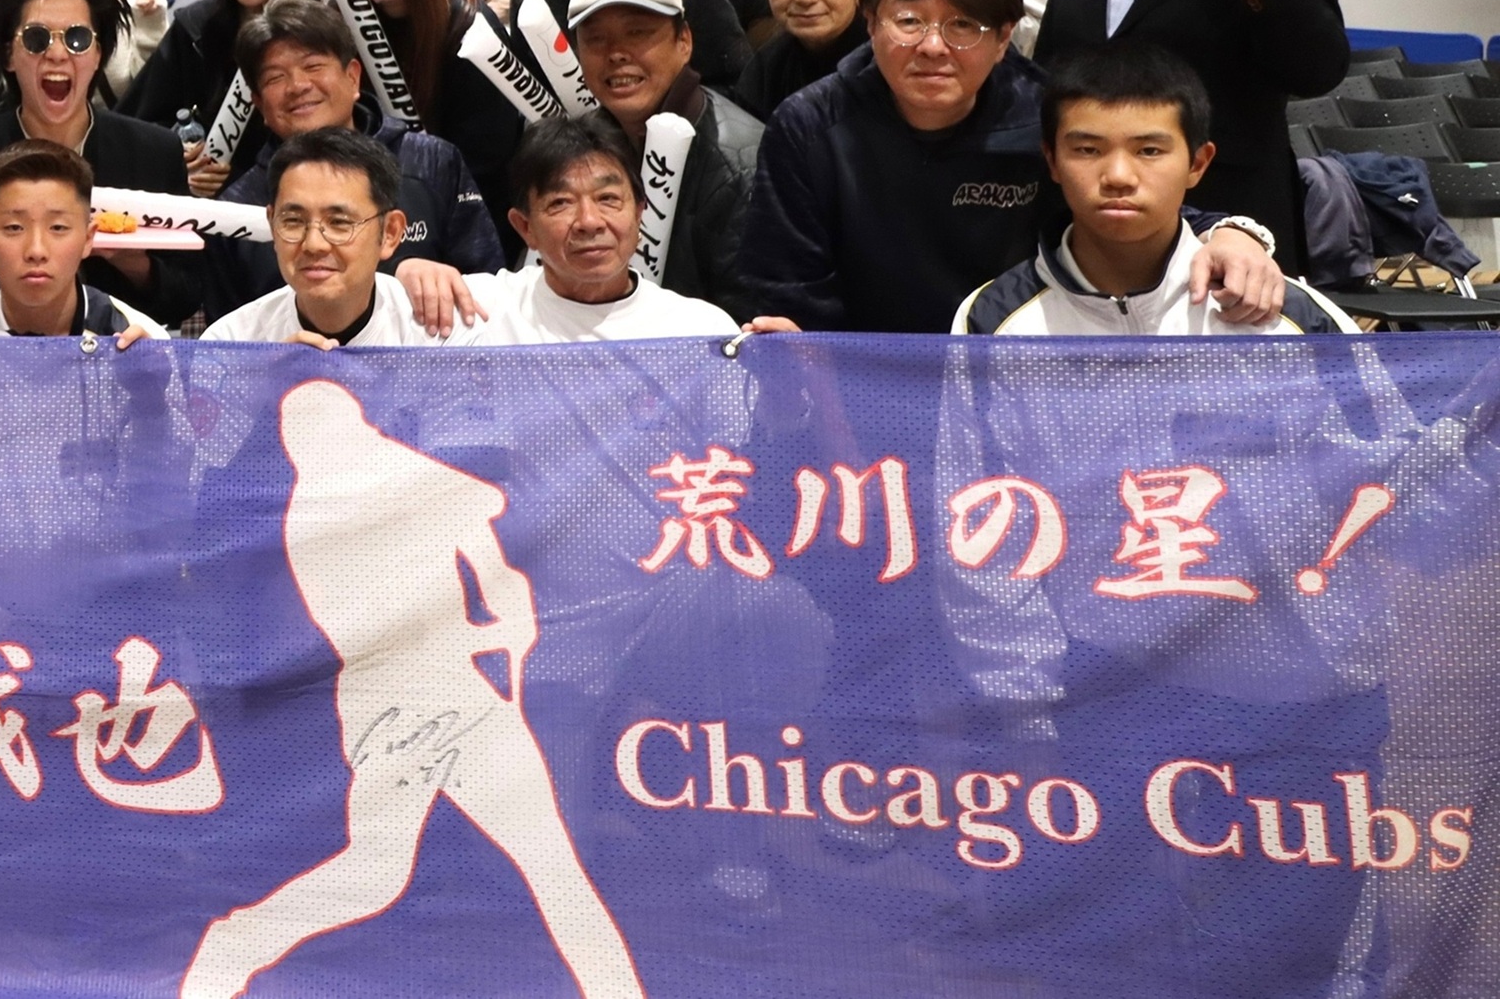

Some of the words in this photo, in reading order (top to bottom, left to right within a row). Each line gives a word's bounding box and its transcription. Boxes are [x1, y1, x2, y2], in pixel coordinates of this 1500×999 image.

[638, 445, 1396, 603] 荒川の星!
[614, 717, 1102, 869] Chicago
[1143, 758, 1474, 871] Cubs
